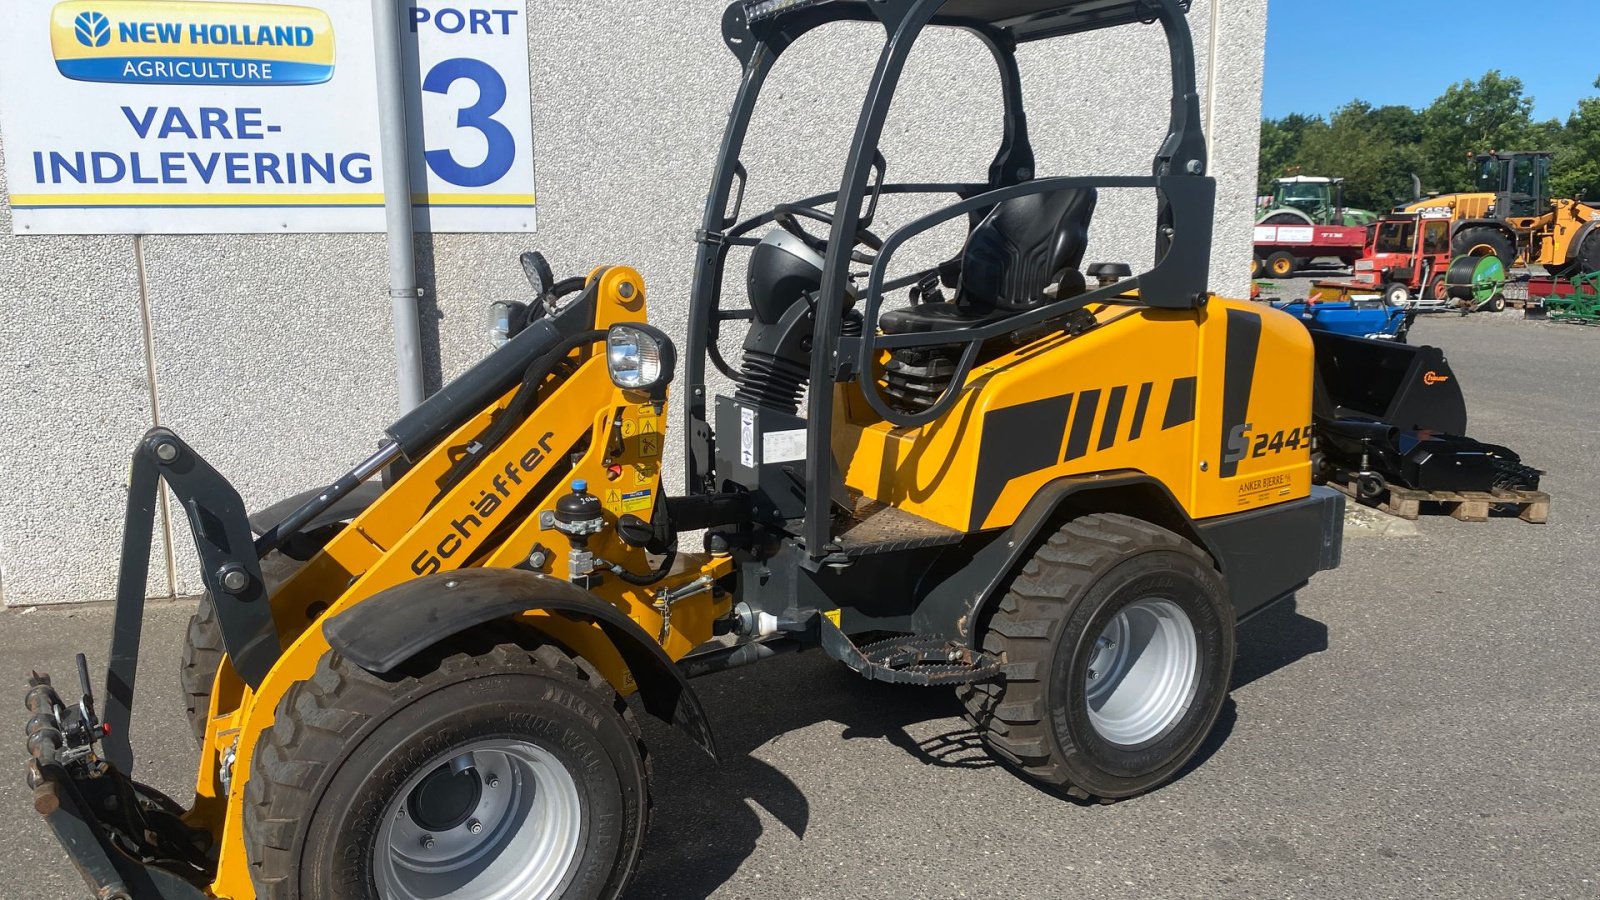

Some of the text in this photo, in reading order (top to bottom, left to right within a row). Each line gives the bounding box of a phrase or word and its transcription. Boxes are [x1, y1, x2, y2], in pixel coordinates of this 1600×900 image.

[118, 21, 315, 47] NEW HOLLAND
[410, 7, 518, 34] PORT
[122, 60, 273, 80] AGRICULTURE
[120, 105, 282, 140] VARE-
[422, 57, 517, 188] 3
[32, 150, 374, 185] INDLEVERING
[1224, 423, 1312, 463] S 2445
[411, 431, 555, 576] Schäffer
[1238, 479, 1262, 493] ANKER
